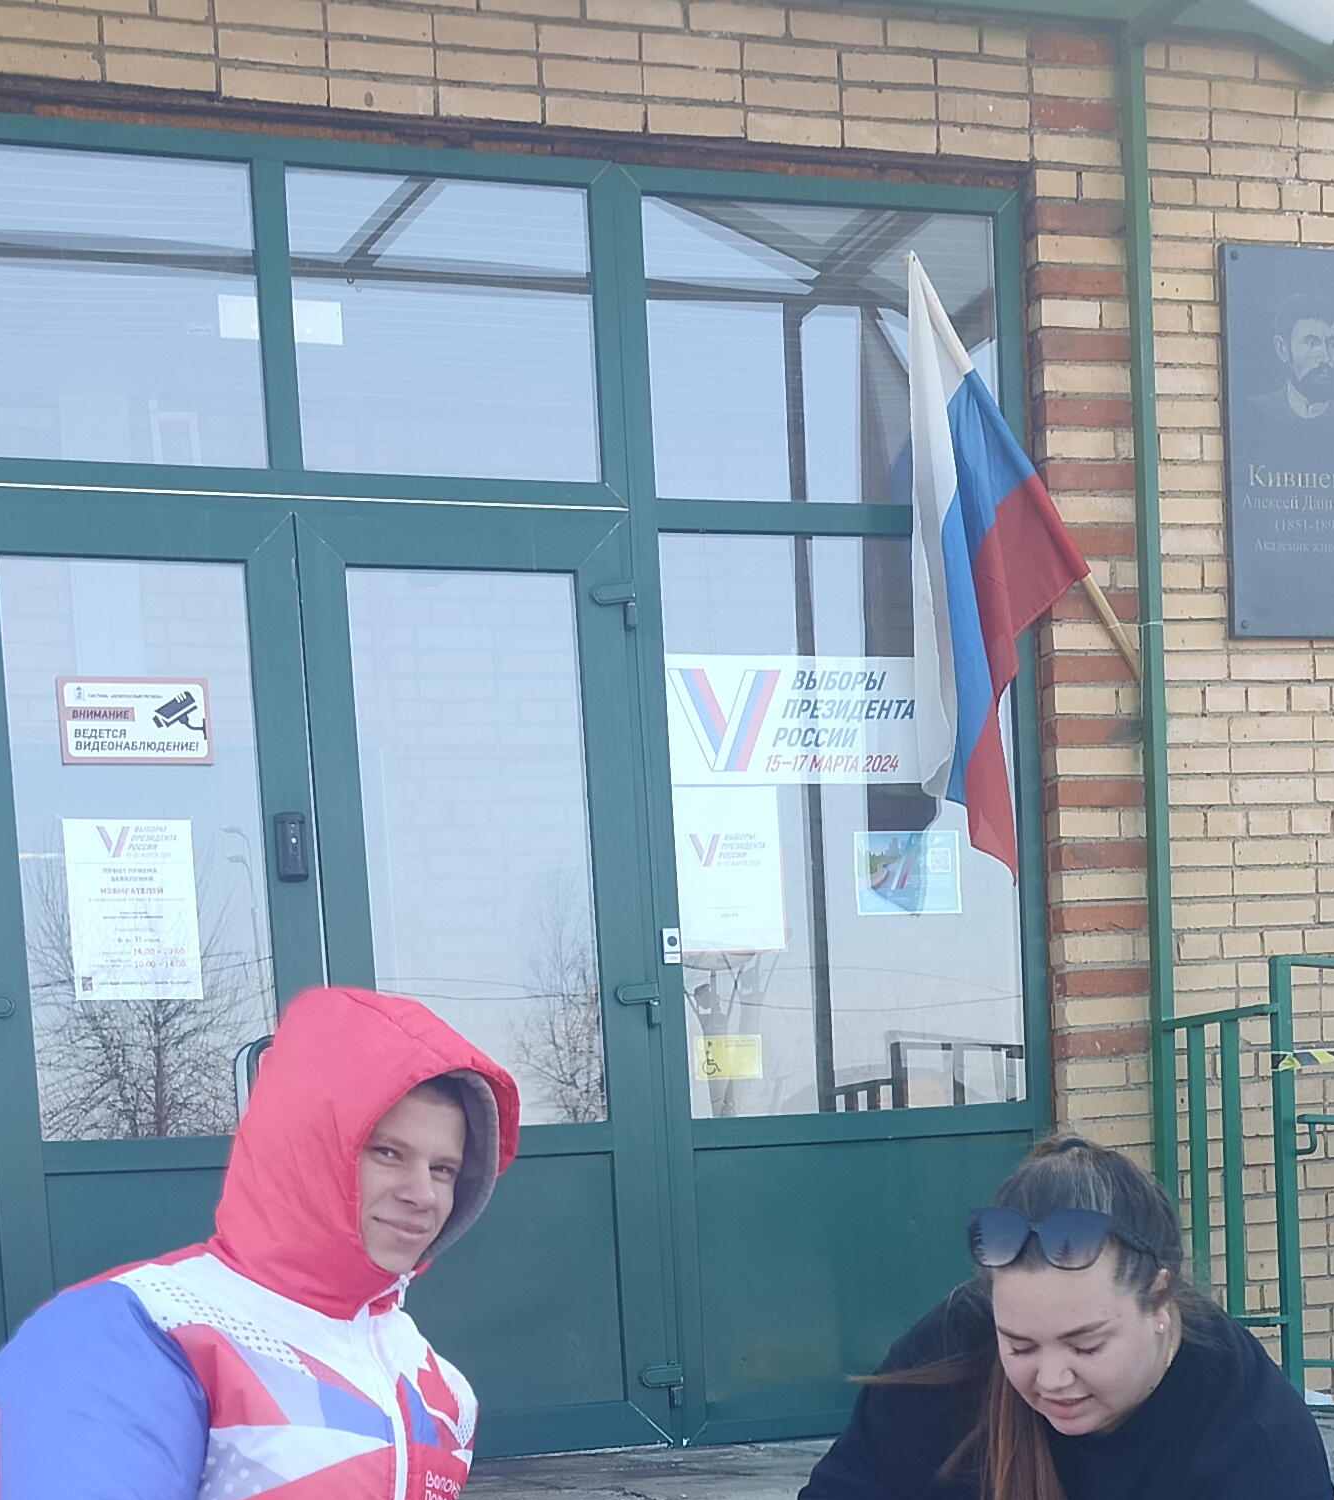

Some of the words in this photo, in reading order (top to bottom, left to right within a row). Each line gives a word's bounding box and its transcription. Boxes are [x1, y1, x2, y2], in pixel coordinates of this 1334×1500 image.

[1242, 494, 1299, 510] Алексей
[1254, 538, 1309, 552] Академик
[791, 670, 887, 691] ВЫБОРЫ
[71, 709, 130, 719] ВНИМАНИЕ
[782, 699, 915, 723] ПРЕЗИДЕНТА
[74, 728, 127, 739] ВЕДЕТСЯ
[772, 727, 859, 748] РОССИИ
[75, 741, 199, 753] ВИДЕОНАБЛЮДЕНИЕ!
[809, 755, 859, 772] МАРТА
[862, 754, 899, 772] 2024
[134, 825, 168, 833] ВЫБОРЫ
[130, 834, 177, 842] ПРЕЗИДЕНТА
[724, 832, 757, 841] ВЫБОРЫ
[127, 843, 158, 851] РОССИИ
[721, 842, 766, 850] ПРЕЗИДЕНТА
[718, 851, 747, 859] РОССИИ
[99, 886, 164, 895] ИЗБИРАТЕЛЕЙ
